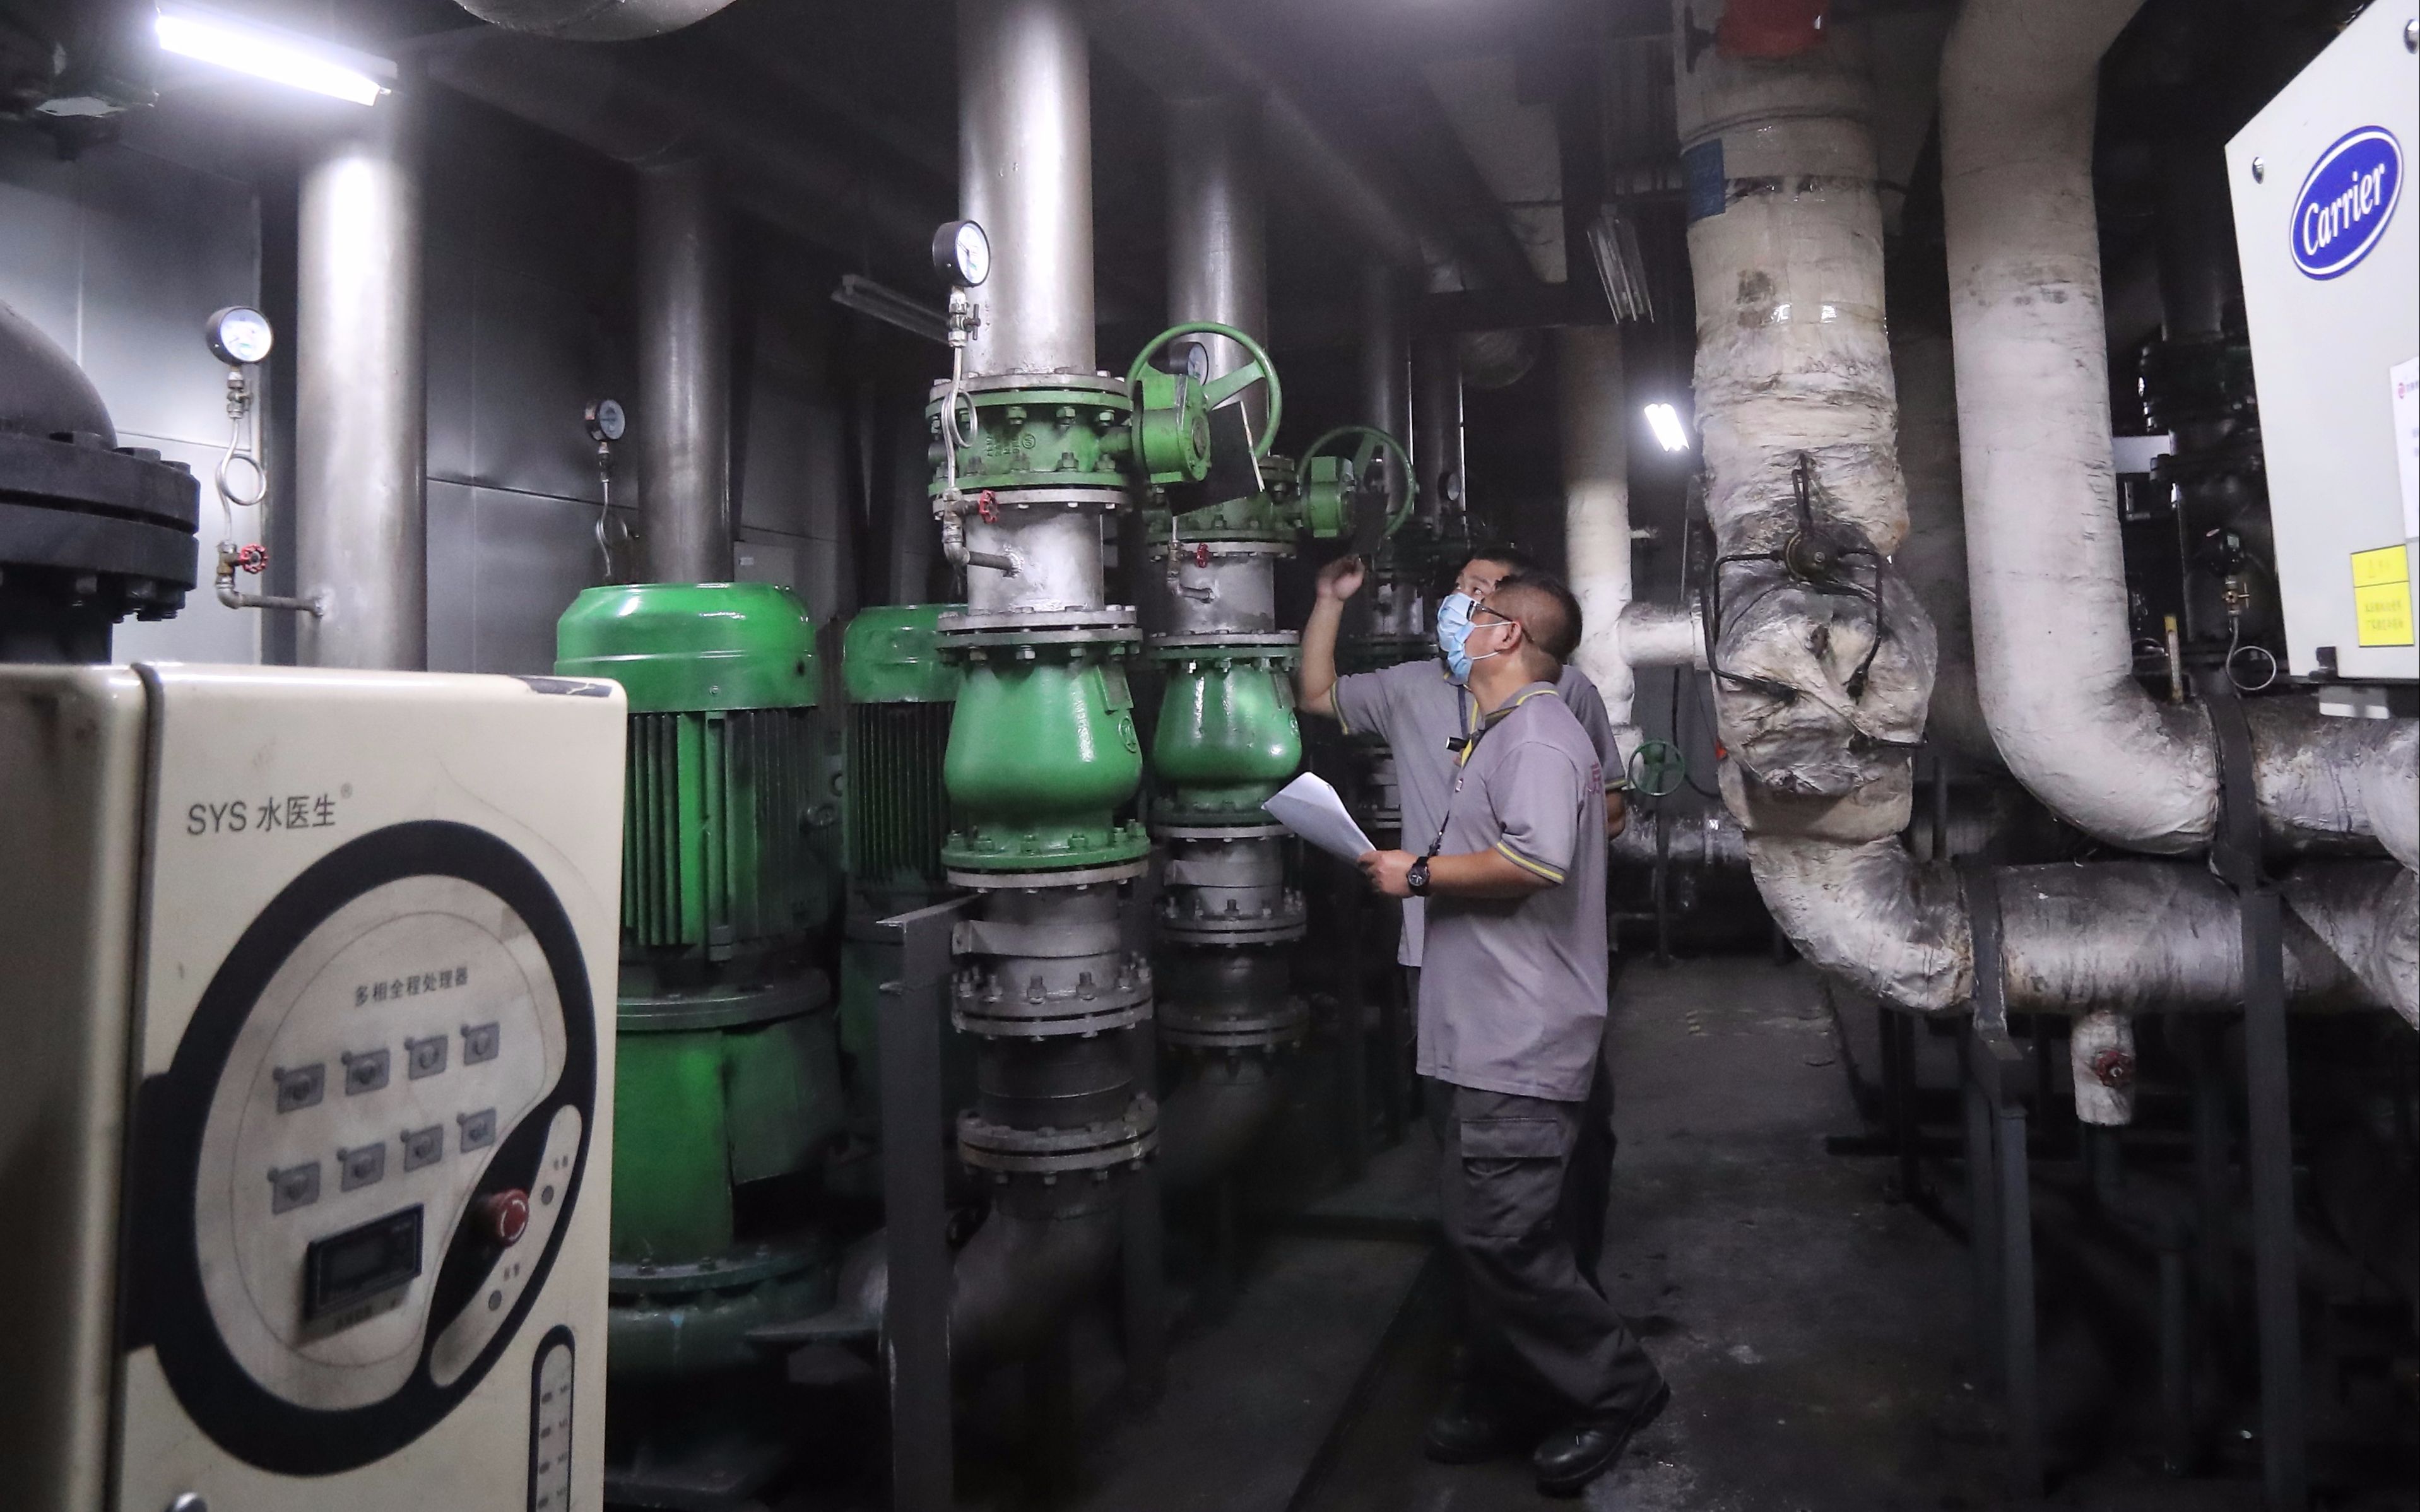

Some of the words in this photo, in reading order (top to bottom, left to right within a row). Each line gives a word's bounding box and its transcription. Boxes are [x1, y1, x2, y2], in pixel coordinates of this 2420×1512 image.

[2304, 163, 2385, 256] Carrier
[187, 800, 247, 836] SYS
[256, 794, 336, 832] 水医生
